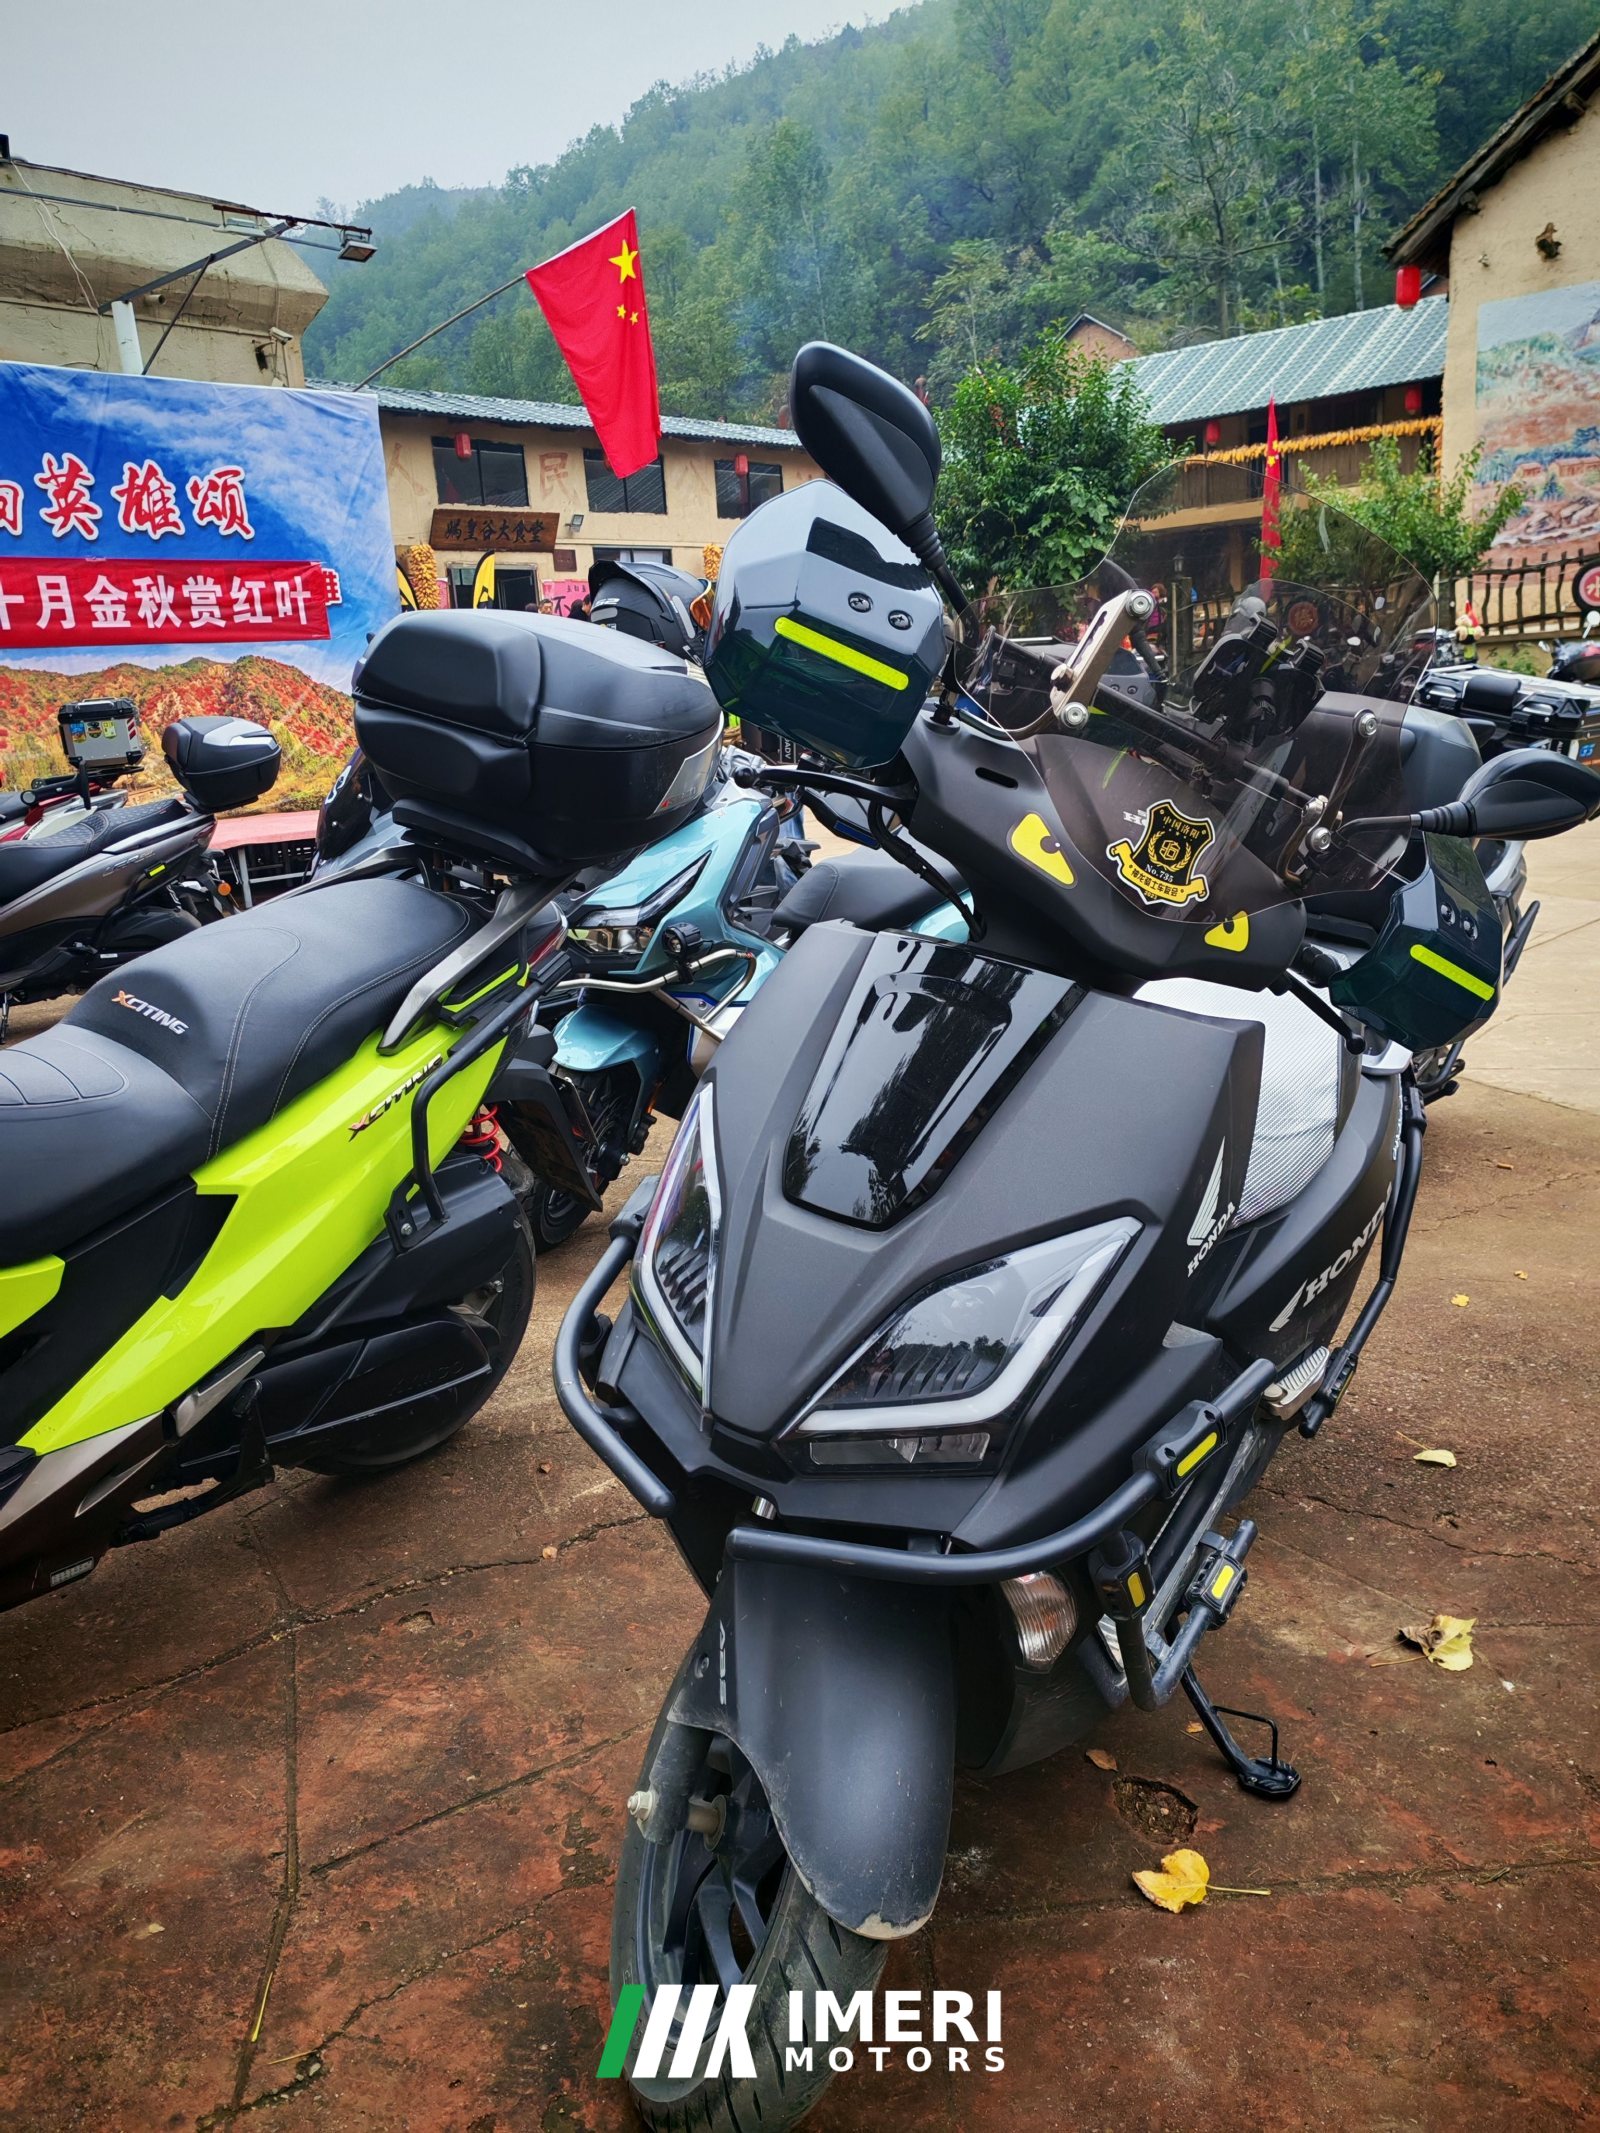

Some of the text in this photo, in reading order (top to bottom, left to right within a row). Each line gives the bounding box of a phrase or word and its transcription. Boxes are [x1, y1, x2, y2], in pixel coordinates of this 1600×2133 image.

[0, 575, 312, 631] 十月金秋赏红叶
[111, 989, 189, 1035] XCITING
[1188, 1202, 1235, 1277] HONDA
